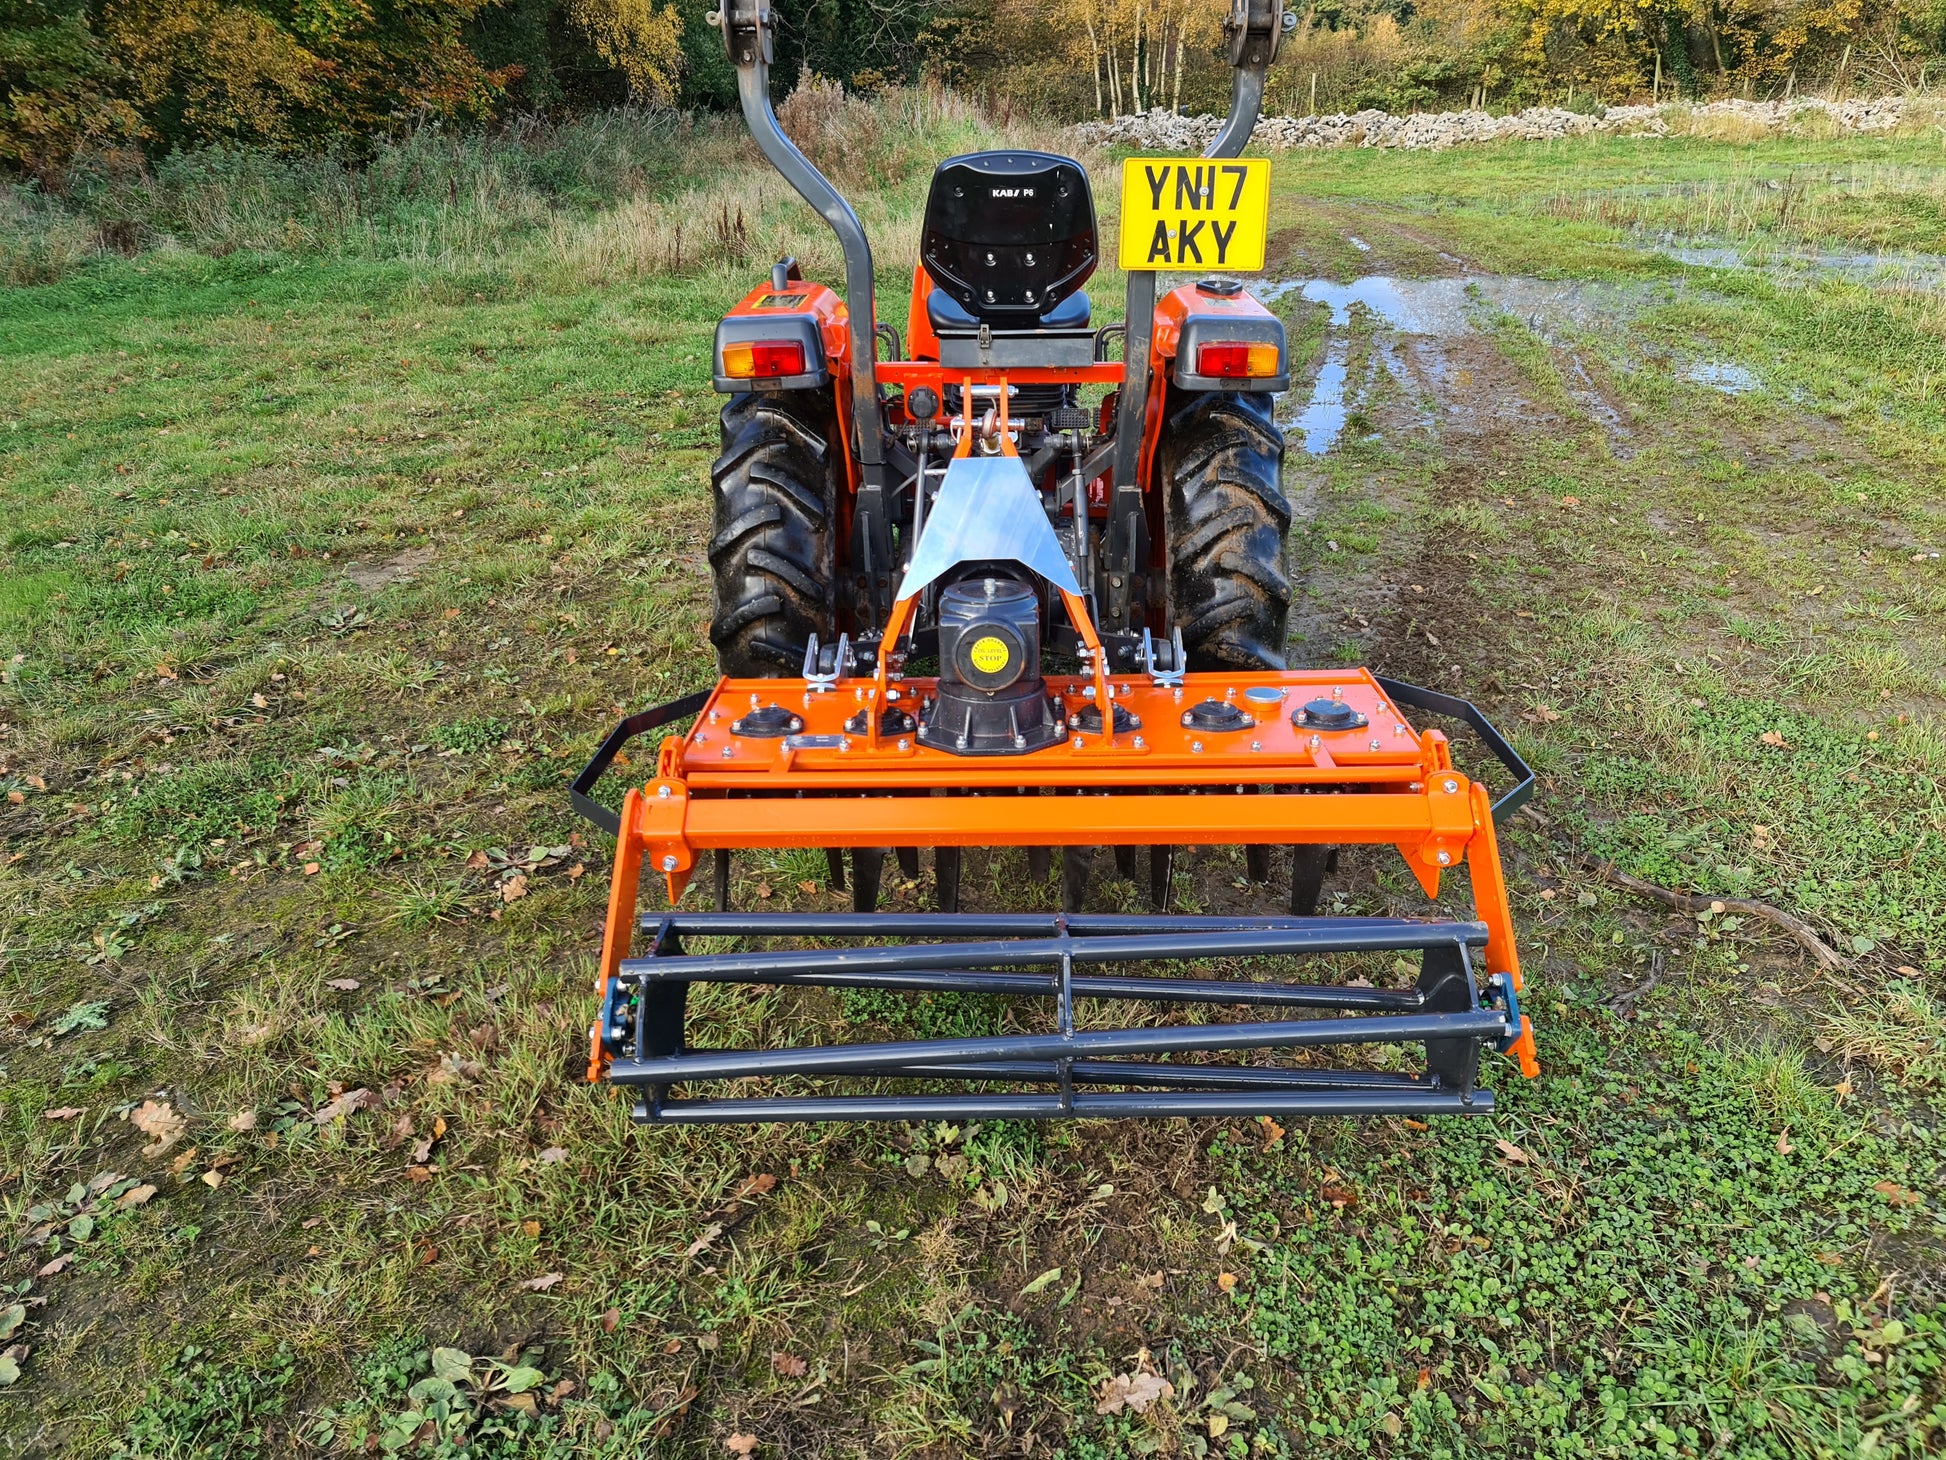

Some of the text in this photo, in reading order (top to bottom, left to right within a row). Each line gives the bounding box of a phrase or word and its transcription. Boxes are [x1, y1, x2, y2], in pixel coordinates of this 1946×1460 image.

[1023, 188, 1034, 197] P6
[1145, 166, 1248, 210] YN17
[1147, 220, 1237, 264] AKY
